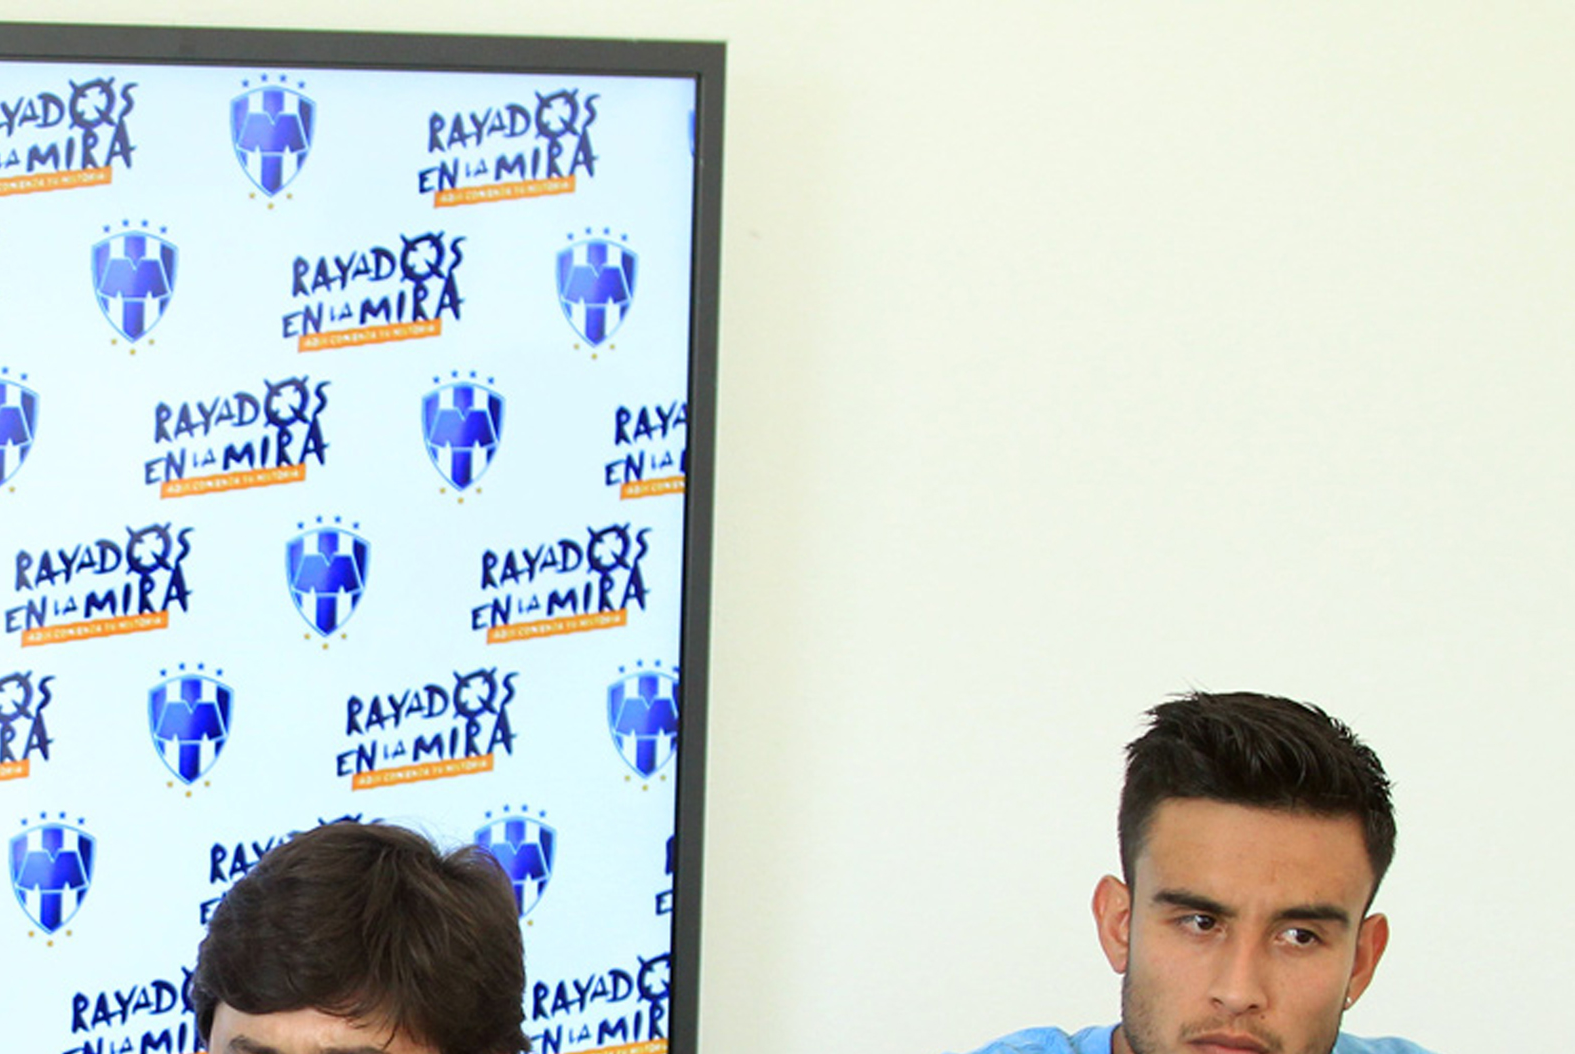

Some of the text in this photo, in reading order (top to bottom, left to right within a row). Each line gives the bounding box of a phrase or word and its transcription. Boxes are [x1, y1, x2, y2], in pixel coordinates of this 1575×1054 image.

[26, 118, 136, 171] MIRA
[428, 86, 600, 151] RAYADOS
[418, 157, 457, 192] EN
[466, 157, 487, 176] LA
[495, 127, 599, 178] MIRA
[292, 230, 466, 296] RAYADOS
[282, 302, 322, 337] EN
[330, 302, 352, 321] LA
[359, 270, 465, 323] MIRA
[154, 375, 330, 443] RAYADOS
[615, 399, 687, 446] RAYA
[144, 448, 184, 484] EN
[193, 448, 215, 467] LA
[222, 416, 329, 469] MIRA
[605, 448, 674, 486] EN LA
[15, 522, 193, 591] RAYADOS
[482, 521, 652, 589] RAYADOS
[4, 596, 45, 633] EN
[54, 596, 76, 615] LA
[84, 563, 192, 617] MIRA
[472, 594, 511, 629] EN
[519, 594, 541, 612] LA
[548, 561, 651, 614] MIRA
[347, 666, 519, 735] RAYADOS
[337, 740, 376, 776] EN
[385, 740, 406, 759] LA
[414, 706, 518, 760] MIRA
[572, 1024, 593, 1043] LA
